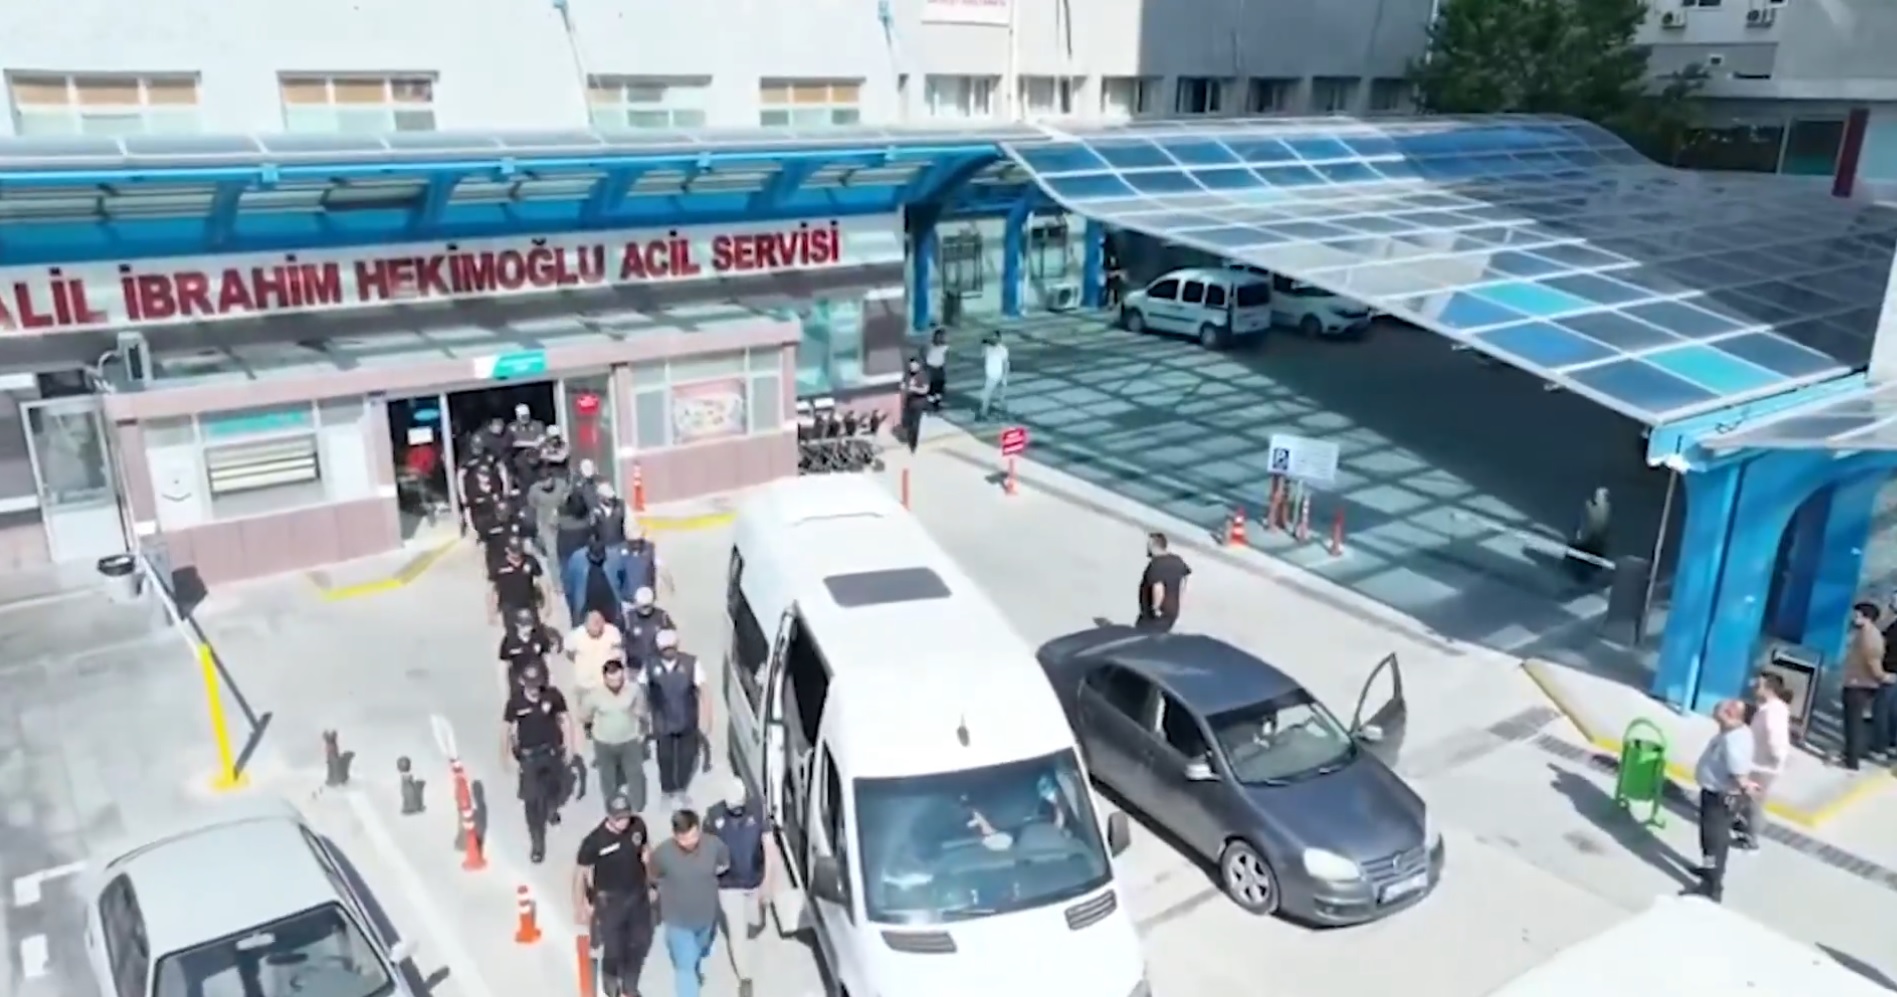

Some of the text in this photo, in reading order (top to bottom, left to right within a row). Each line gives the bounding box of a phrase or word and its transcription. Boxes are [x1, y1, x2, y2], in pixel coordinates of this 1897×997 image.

[119, 254, 342, 320] İBRAHİM
[354, 236, 605, 301] HEKİMOĞLU
[620, 230, 700, 280] ACİL
[713, 219, 839, 270] SERVİSİ
